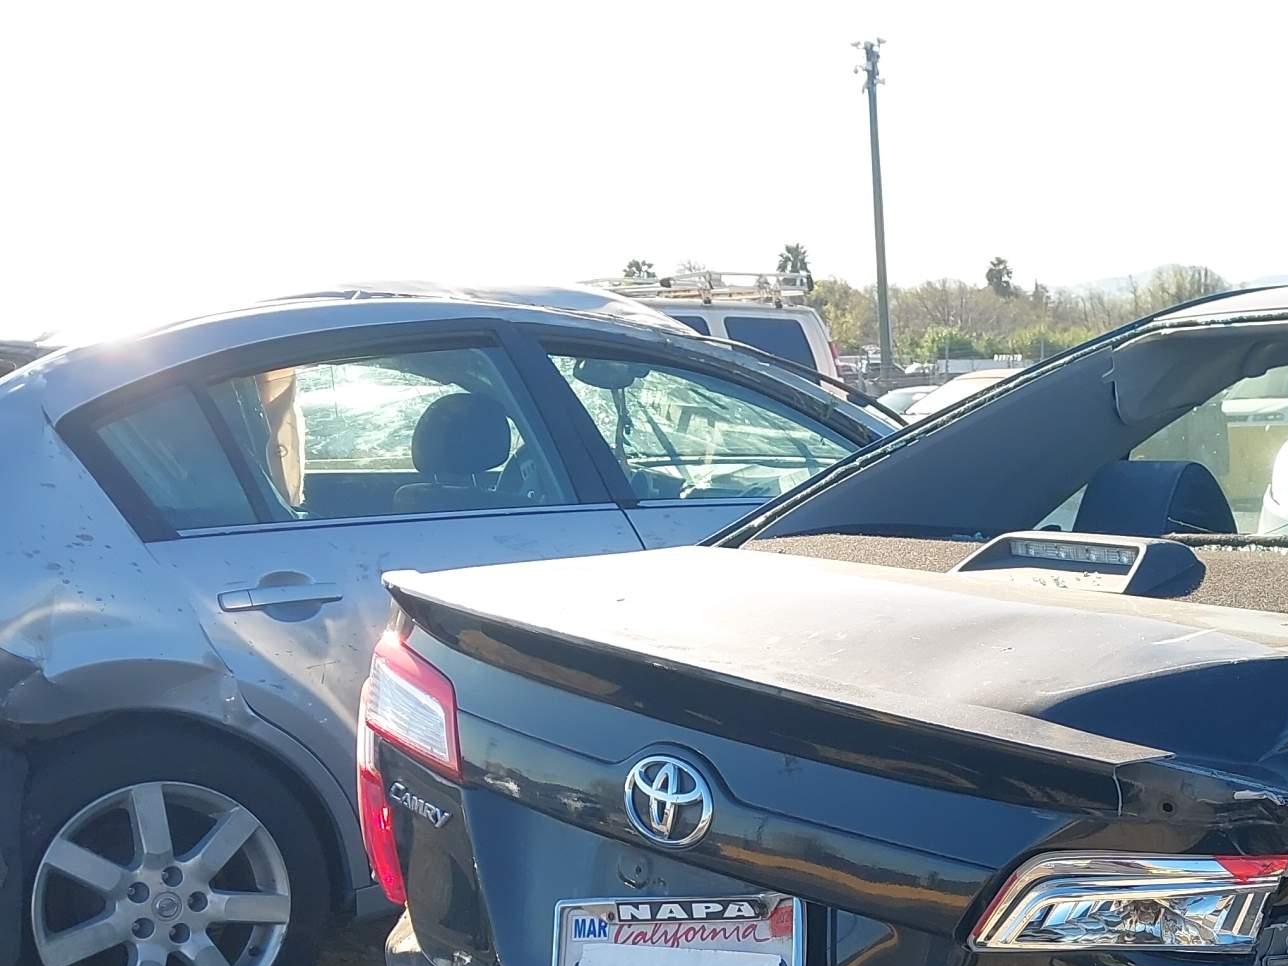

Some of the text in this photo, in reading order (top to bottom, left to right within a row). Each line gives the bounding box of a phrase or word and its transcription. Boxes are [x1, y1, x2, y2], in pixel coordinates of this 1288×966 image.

[618, 901, 756, 920] NAPA
[574, 918, 608, 939] MAR
[614, 922, 770, 948] California
